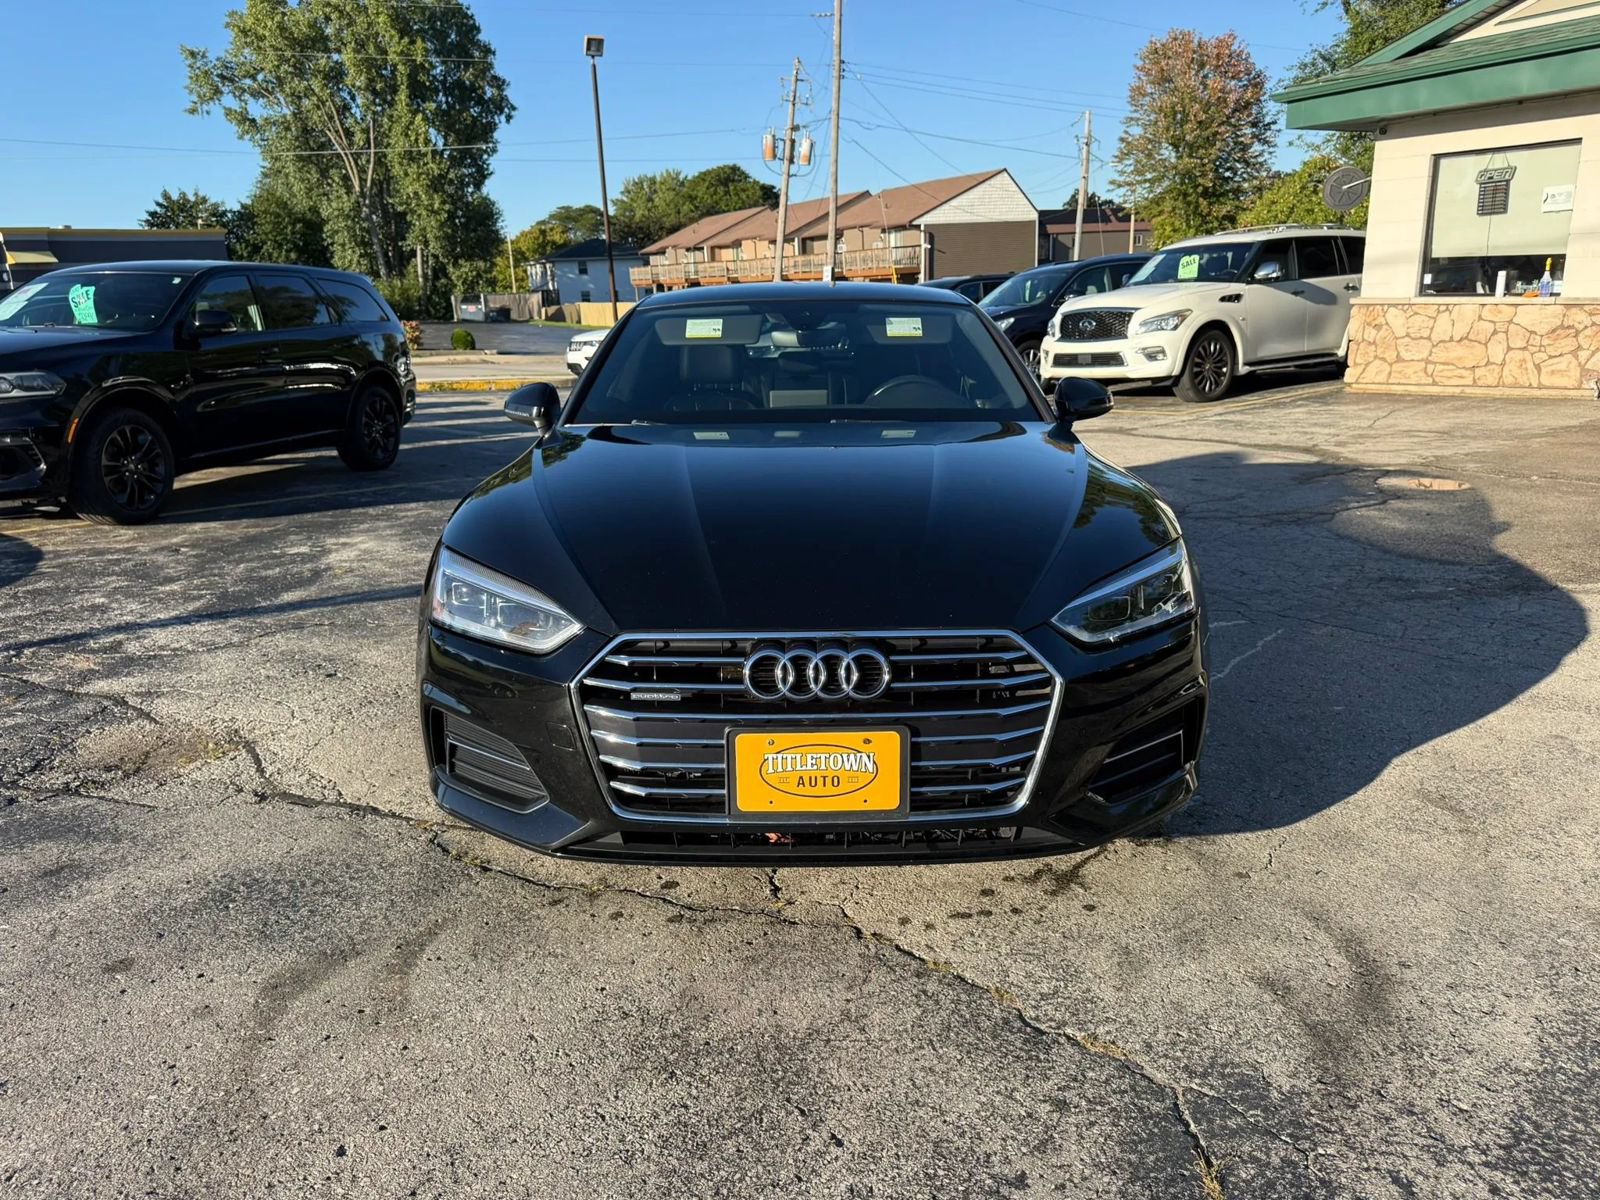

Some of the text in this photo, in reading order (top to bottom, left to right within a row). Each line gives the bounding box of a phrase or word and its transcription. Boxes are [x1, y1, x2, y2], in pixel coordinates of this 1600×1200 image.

[1477, 169, 1511, 181] OPEN
[1181, 257, 1196, 269] SALE
[764, 752, 875, 774] TITLETOWN
[796, 775, 841, 788] AUTO
